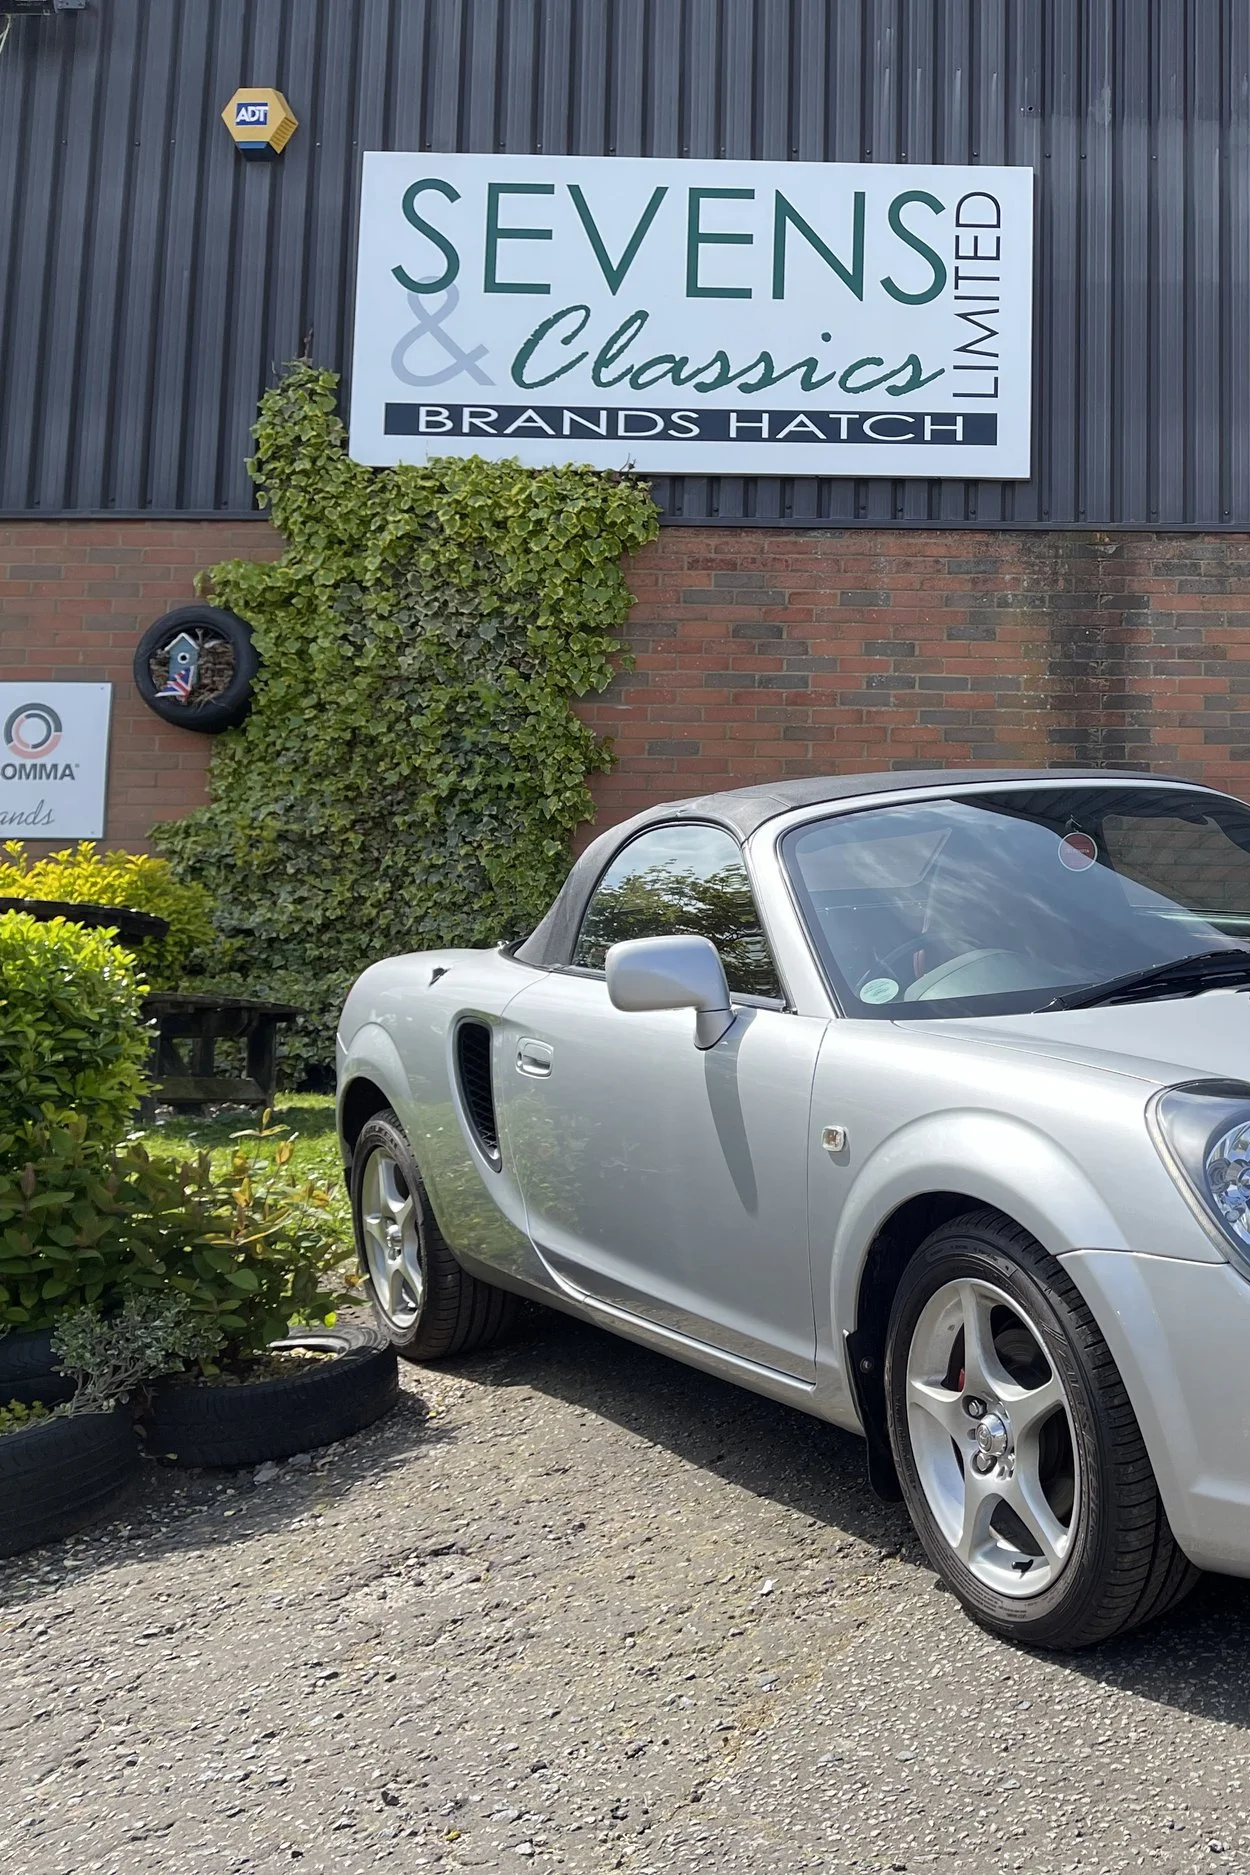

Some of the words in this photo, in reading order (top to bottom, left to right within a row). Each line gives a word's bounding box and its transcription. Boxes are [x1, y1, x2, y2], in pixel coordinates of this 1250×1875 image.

[235, 106, 268, 122] ADT
[391, 178, 947, 305] SEVENS
[953, 191, 1000, 399] LIMITED
[391, 275, 496, 388] &
[511, 304, 945, 397] Classics
[418, 406, 700, 438] BRANDS
[729, 412, 963, 442] HATCH
